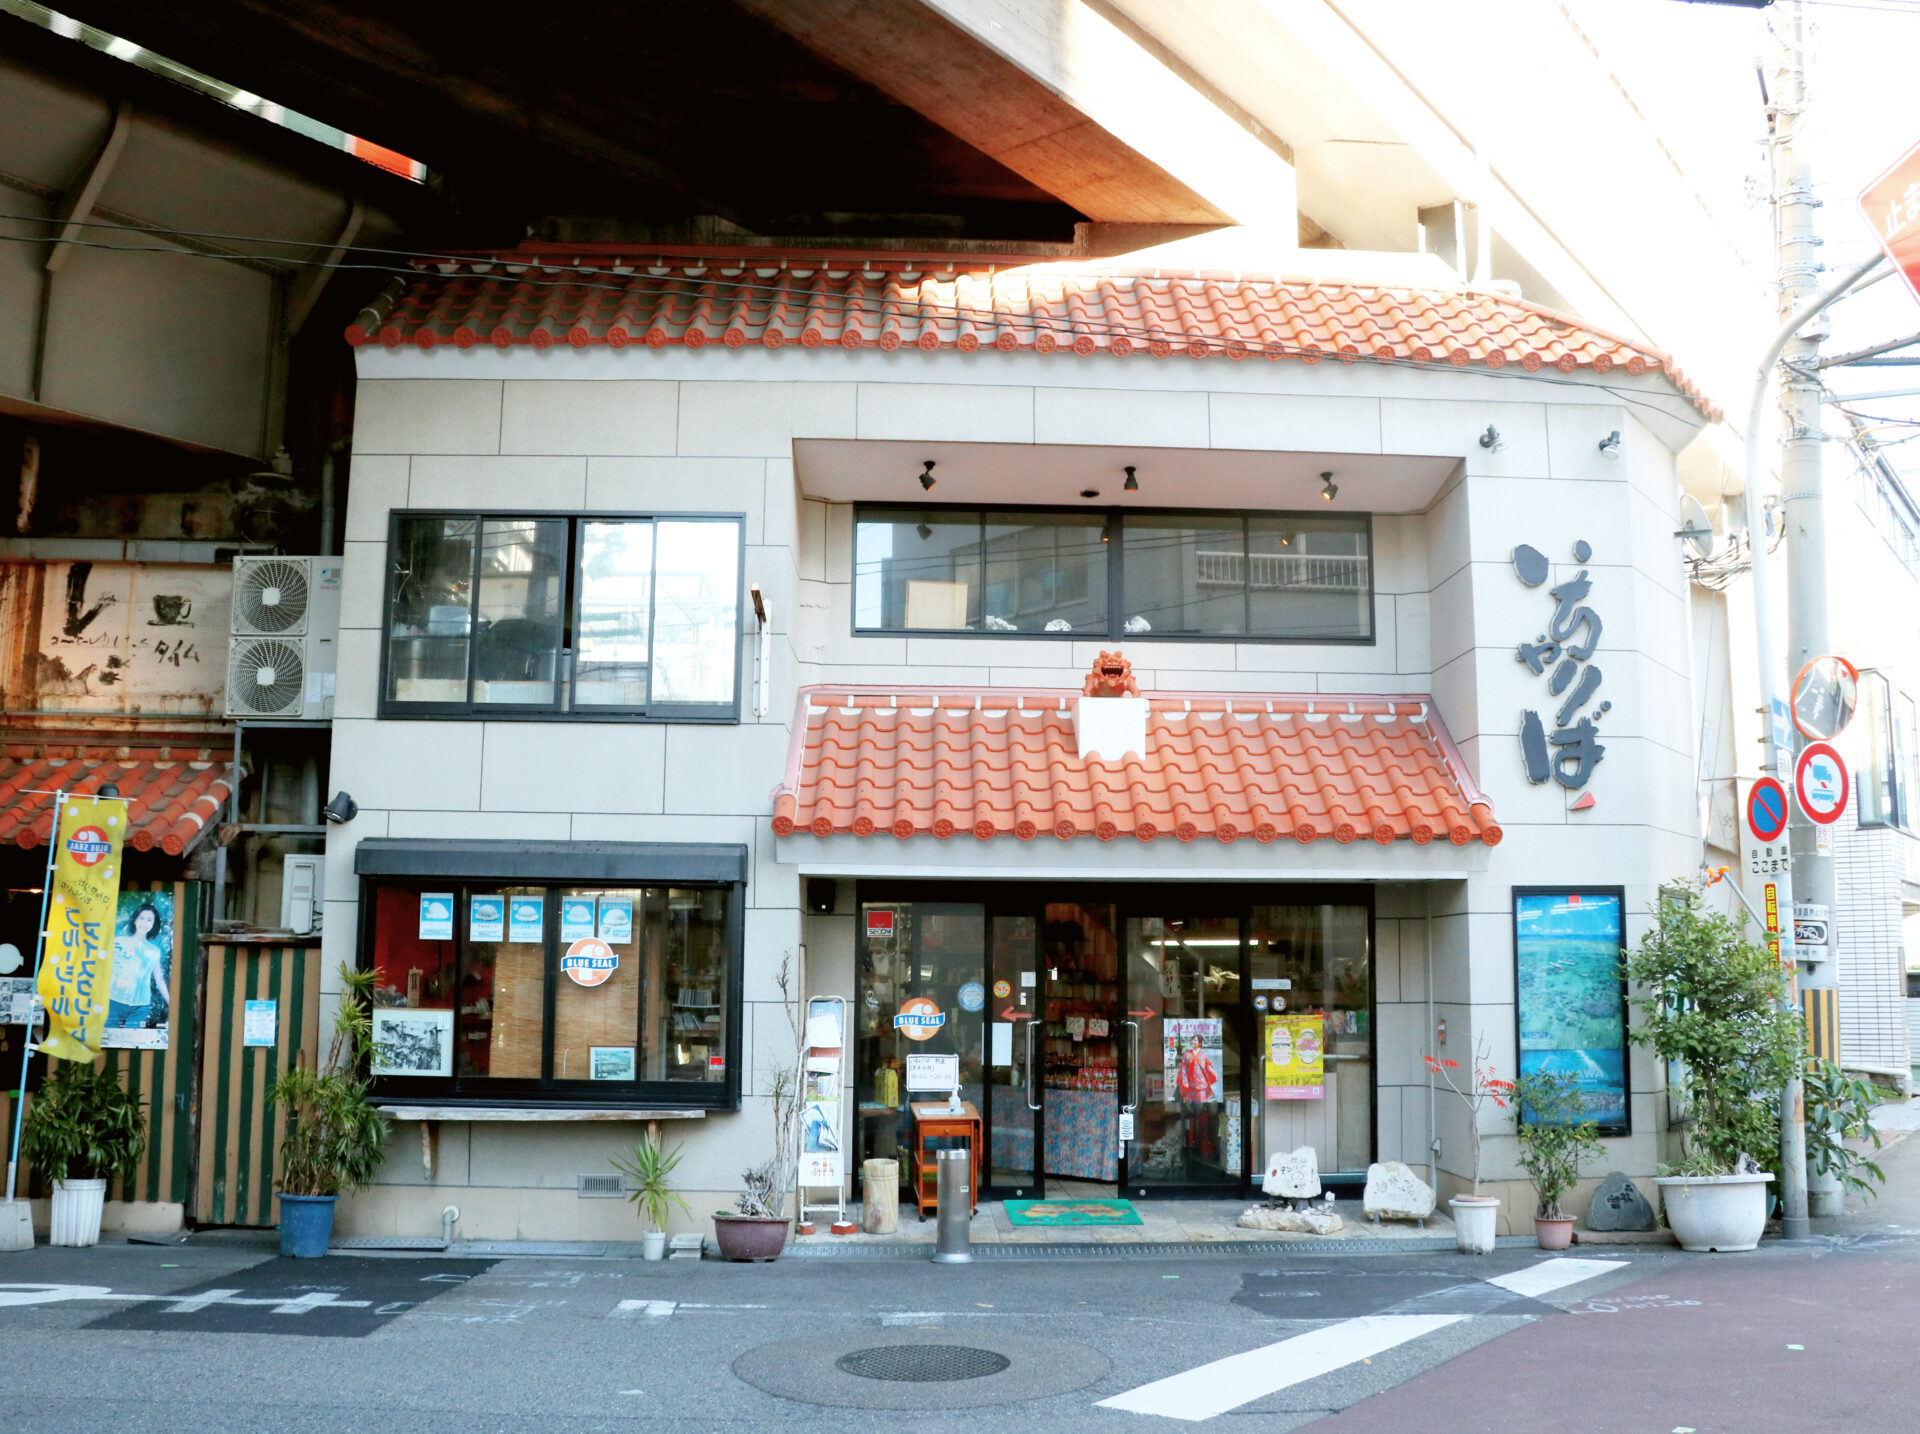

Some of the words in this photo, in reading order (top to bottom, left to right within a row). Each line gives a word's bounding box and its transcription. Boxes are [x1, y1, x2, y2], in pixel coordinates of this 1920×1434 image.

[1511, 539, 1612, 789] いちゃりば
[1752, 846, 1787, 859] 自動車
[1752, 858, 1788, 874] ここまで
[567, 958, 589, 968] BLUE
[591, 958, 613, 968] SEAL
[898, 1016, 919, 1025] BLUE
[920, 1016, 940, 1025] SEAL
